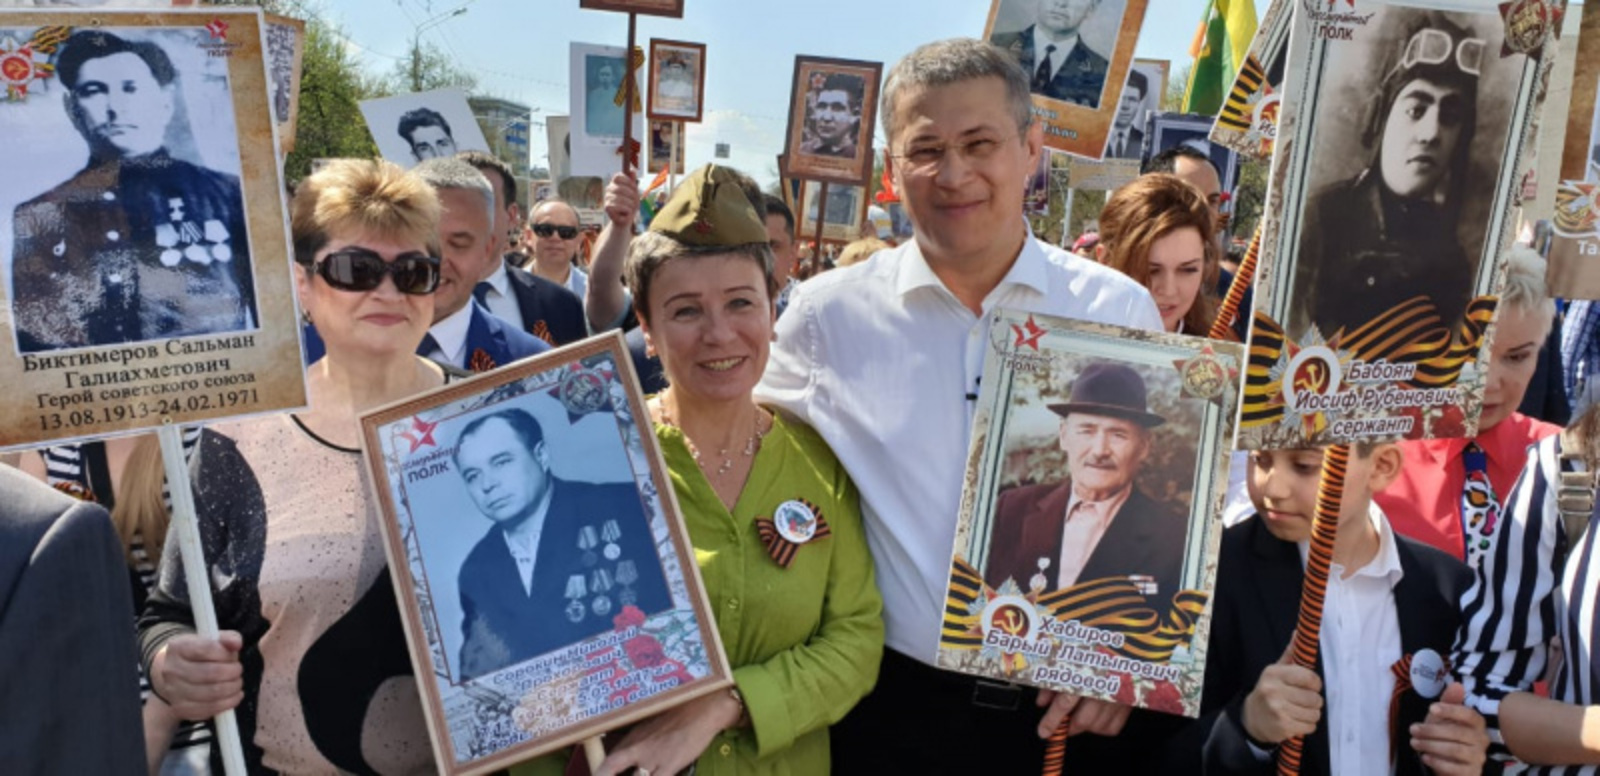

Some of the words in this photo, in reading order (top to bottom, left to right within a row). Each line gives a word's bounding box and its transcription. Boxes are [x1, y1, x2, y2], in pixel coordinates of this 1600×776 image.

[1318, 25, 1354, 41] ПОЛК
[23, 344, 158, 372] Биктимеров
[166, 334, 255, 355] Сальман
[64, 358, 230, 389] Галиахметович
[1350, 361, 1415, 380] Бабоян
[37, 388, 94, 409] Герой
[101, 378, 199, 399] советского
[204, 372, 256, 386] союза
[1295, 390, 1356, 412] Иосиф
[1362, 387, 1456, 411] Рубенович
[40, 390, 259, 431] 13.08.1913-24.02.1971
[1333, 416, 1413, 435] сержант
[408, 461, 449, 483] ПОЛК
[1039, 617, 1124, 647] Хабиров
[493, 654, 564, 685] Сорокин
[566, 628, 637, 659] Николай
[986, 629, 1050, 656] Барый
[1060, 645, 1179, 680] Латыпович
[1034, 666, 1120, 694] рядовой
